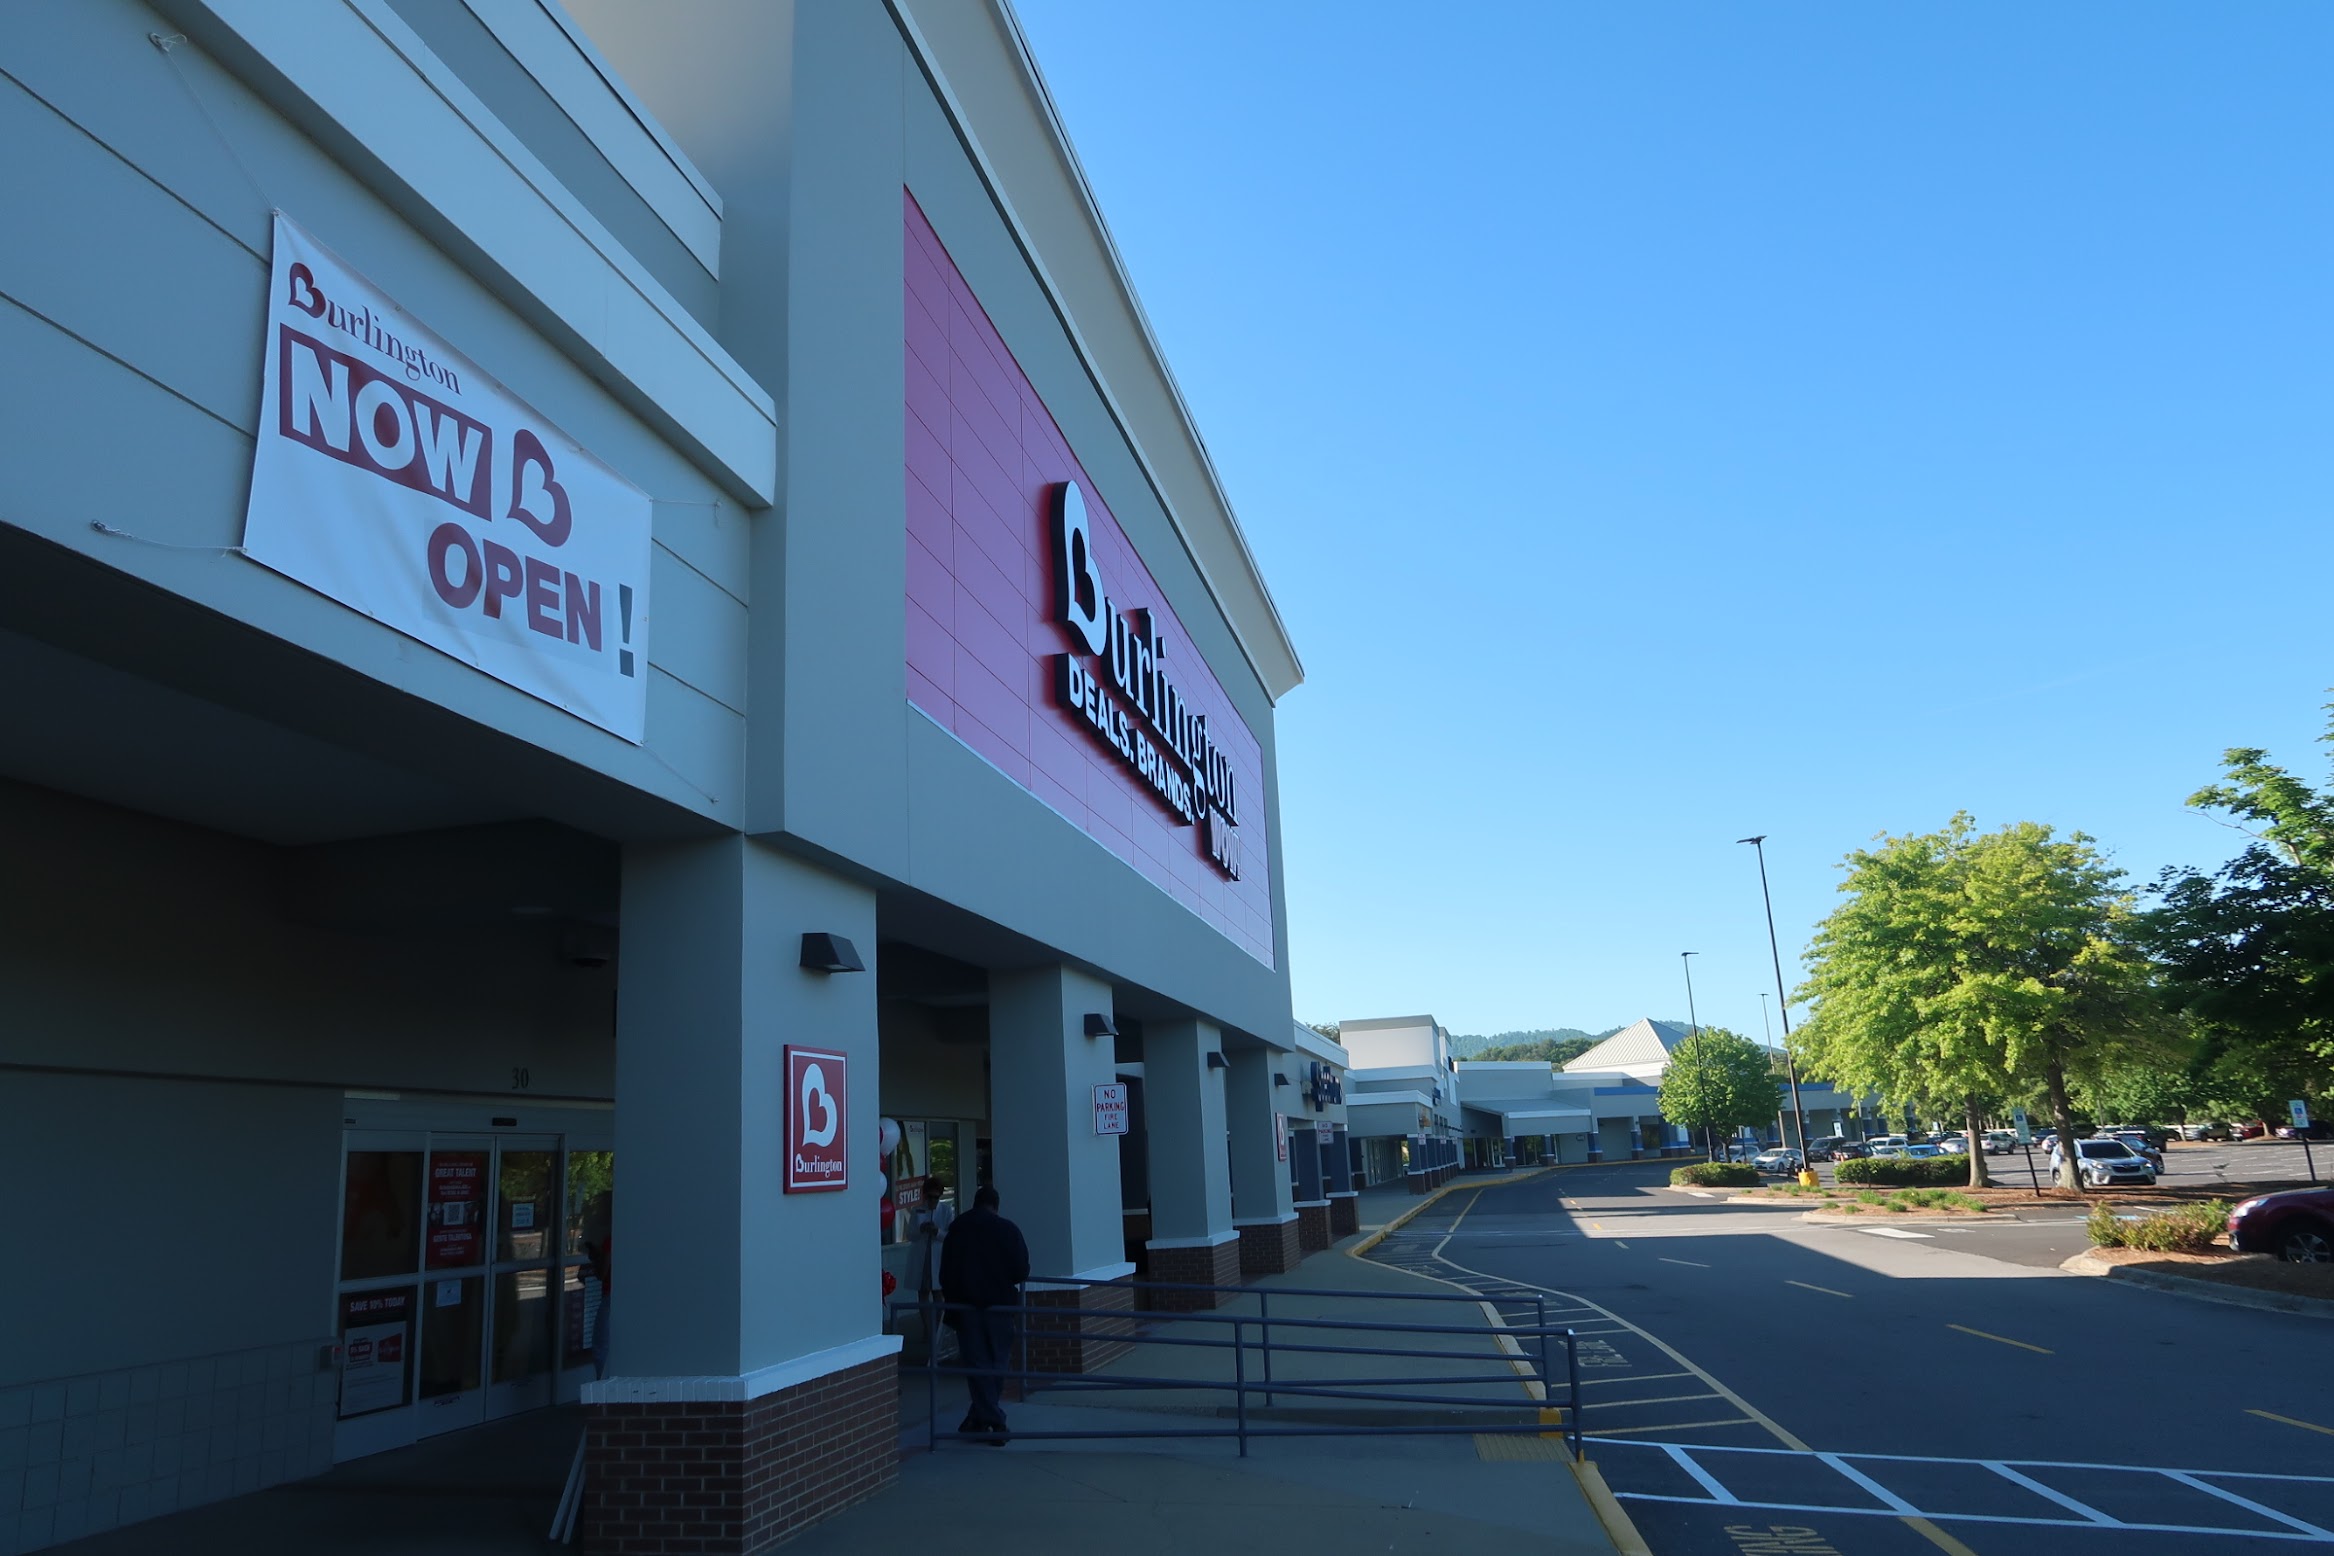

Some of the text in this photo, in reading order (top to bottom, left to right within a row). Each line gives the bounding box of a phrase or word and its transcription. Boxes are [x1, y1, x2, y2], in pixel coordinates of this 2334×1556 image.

[289, 262, 462, 396] Burlington
[290, 339, 484, 504] NOW
[1062, 480, 1240, 826] Burlington
[511, 1067, 529, 1089] 30
[1104, 1089, 1116, 1099] NO
[1096, 1101, 1125, 1113] PARKING
[1103, 1122, 1119, 1130] LANE
[1104, 1113, 1118, 1121] FIRE
[795, 1153, 842, 1178] Burlington
[898, 1187, 921, 1205] STYLE!
[350, 1300, 368, 1312] SAVE
